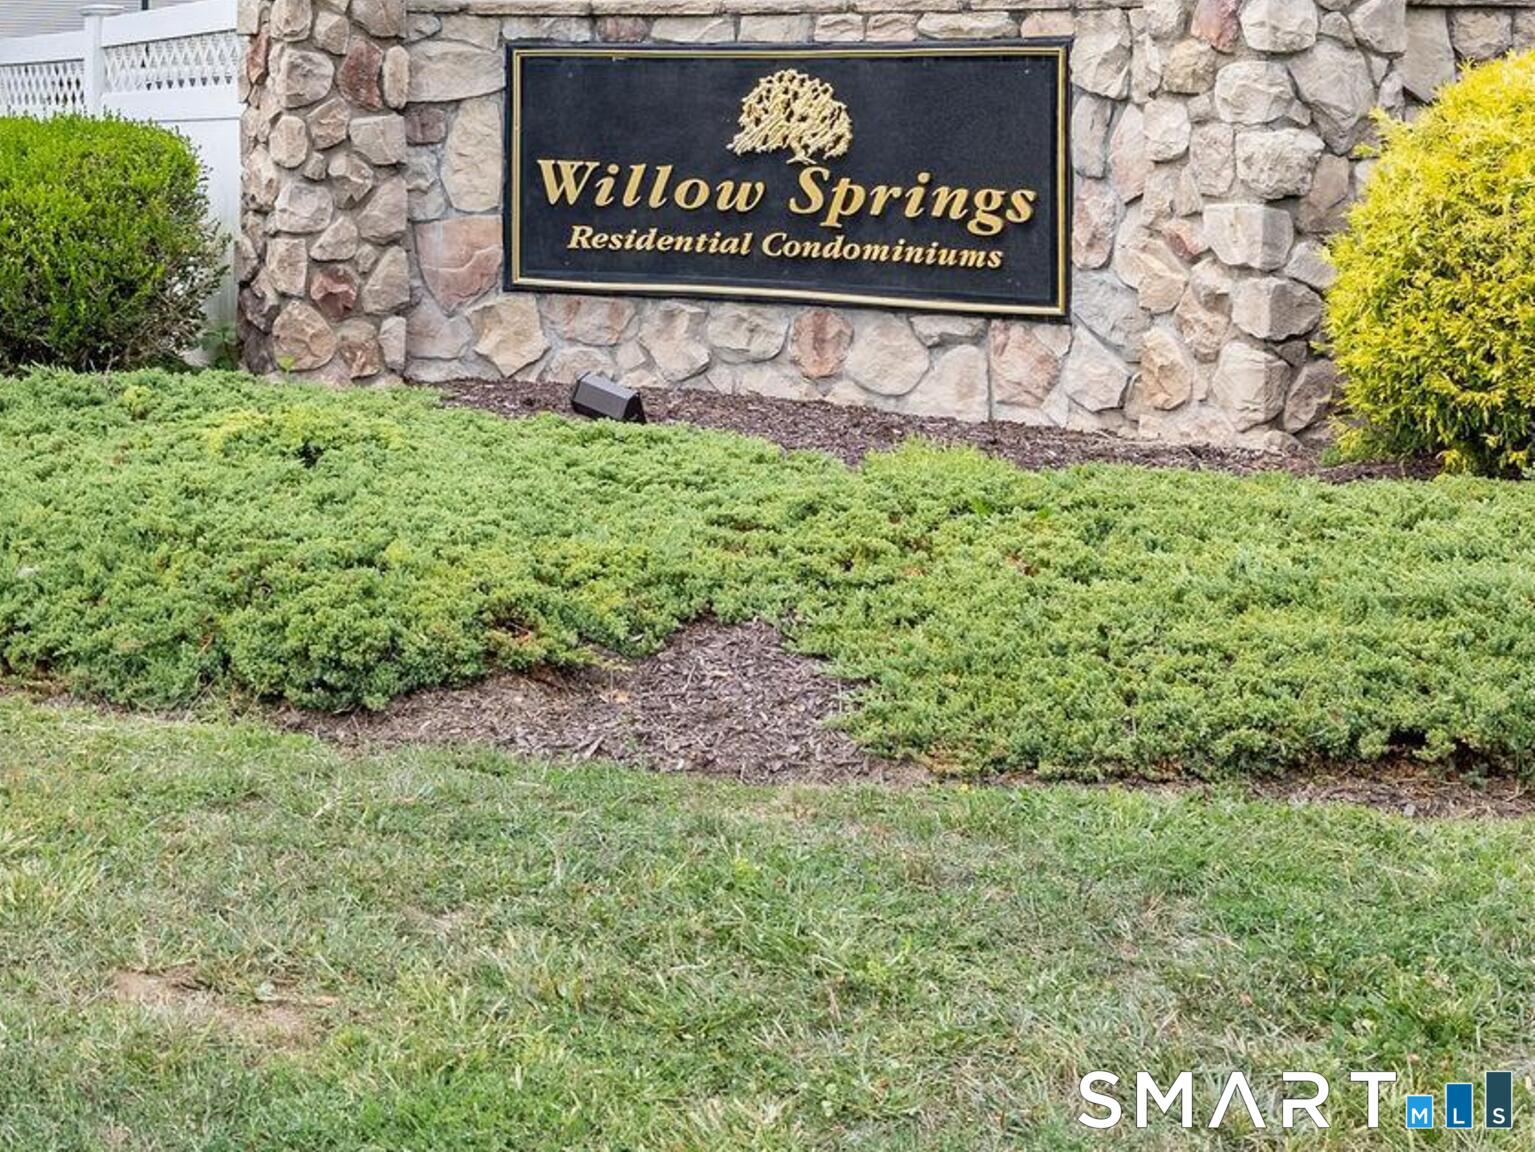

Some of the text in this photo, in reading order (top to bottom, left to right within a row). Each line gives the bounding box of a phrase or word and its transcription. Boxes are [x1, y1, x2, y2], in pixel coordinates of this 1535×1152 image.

[537, 158, 1038, 235] Willow Springs
[567, 225, 1004, 270] Residential Condominiums
